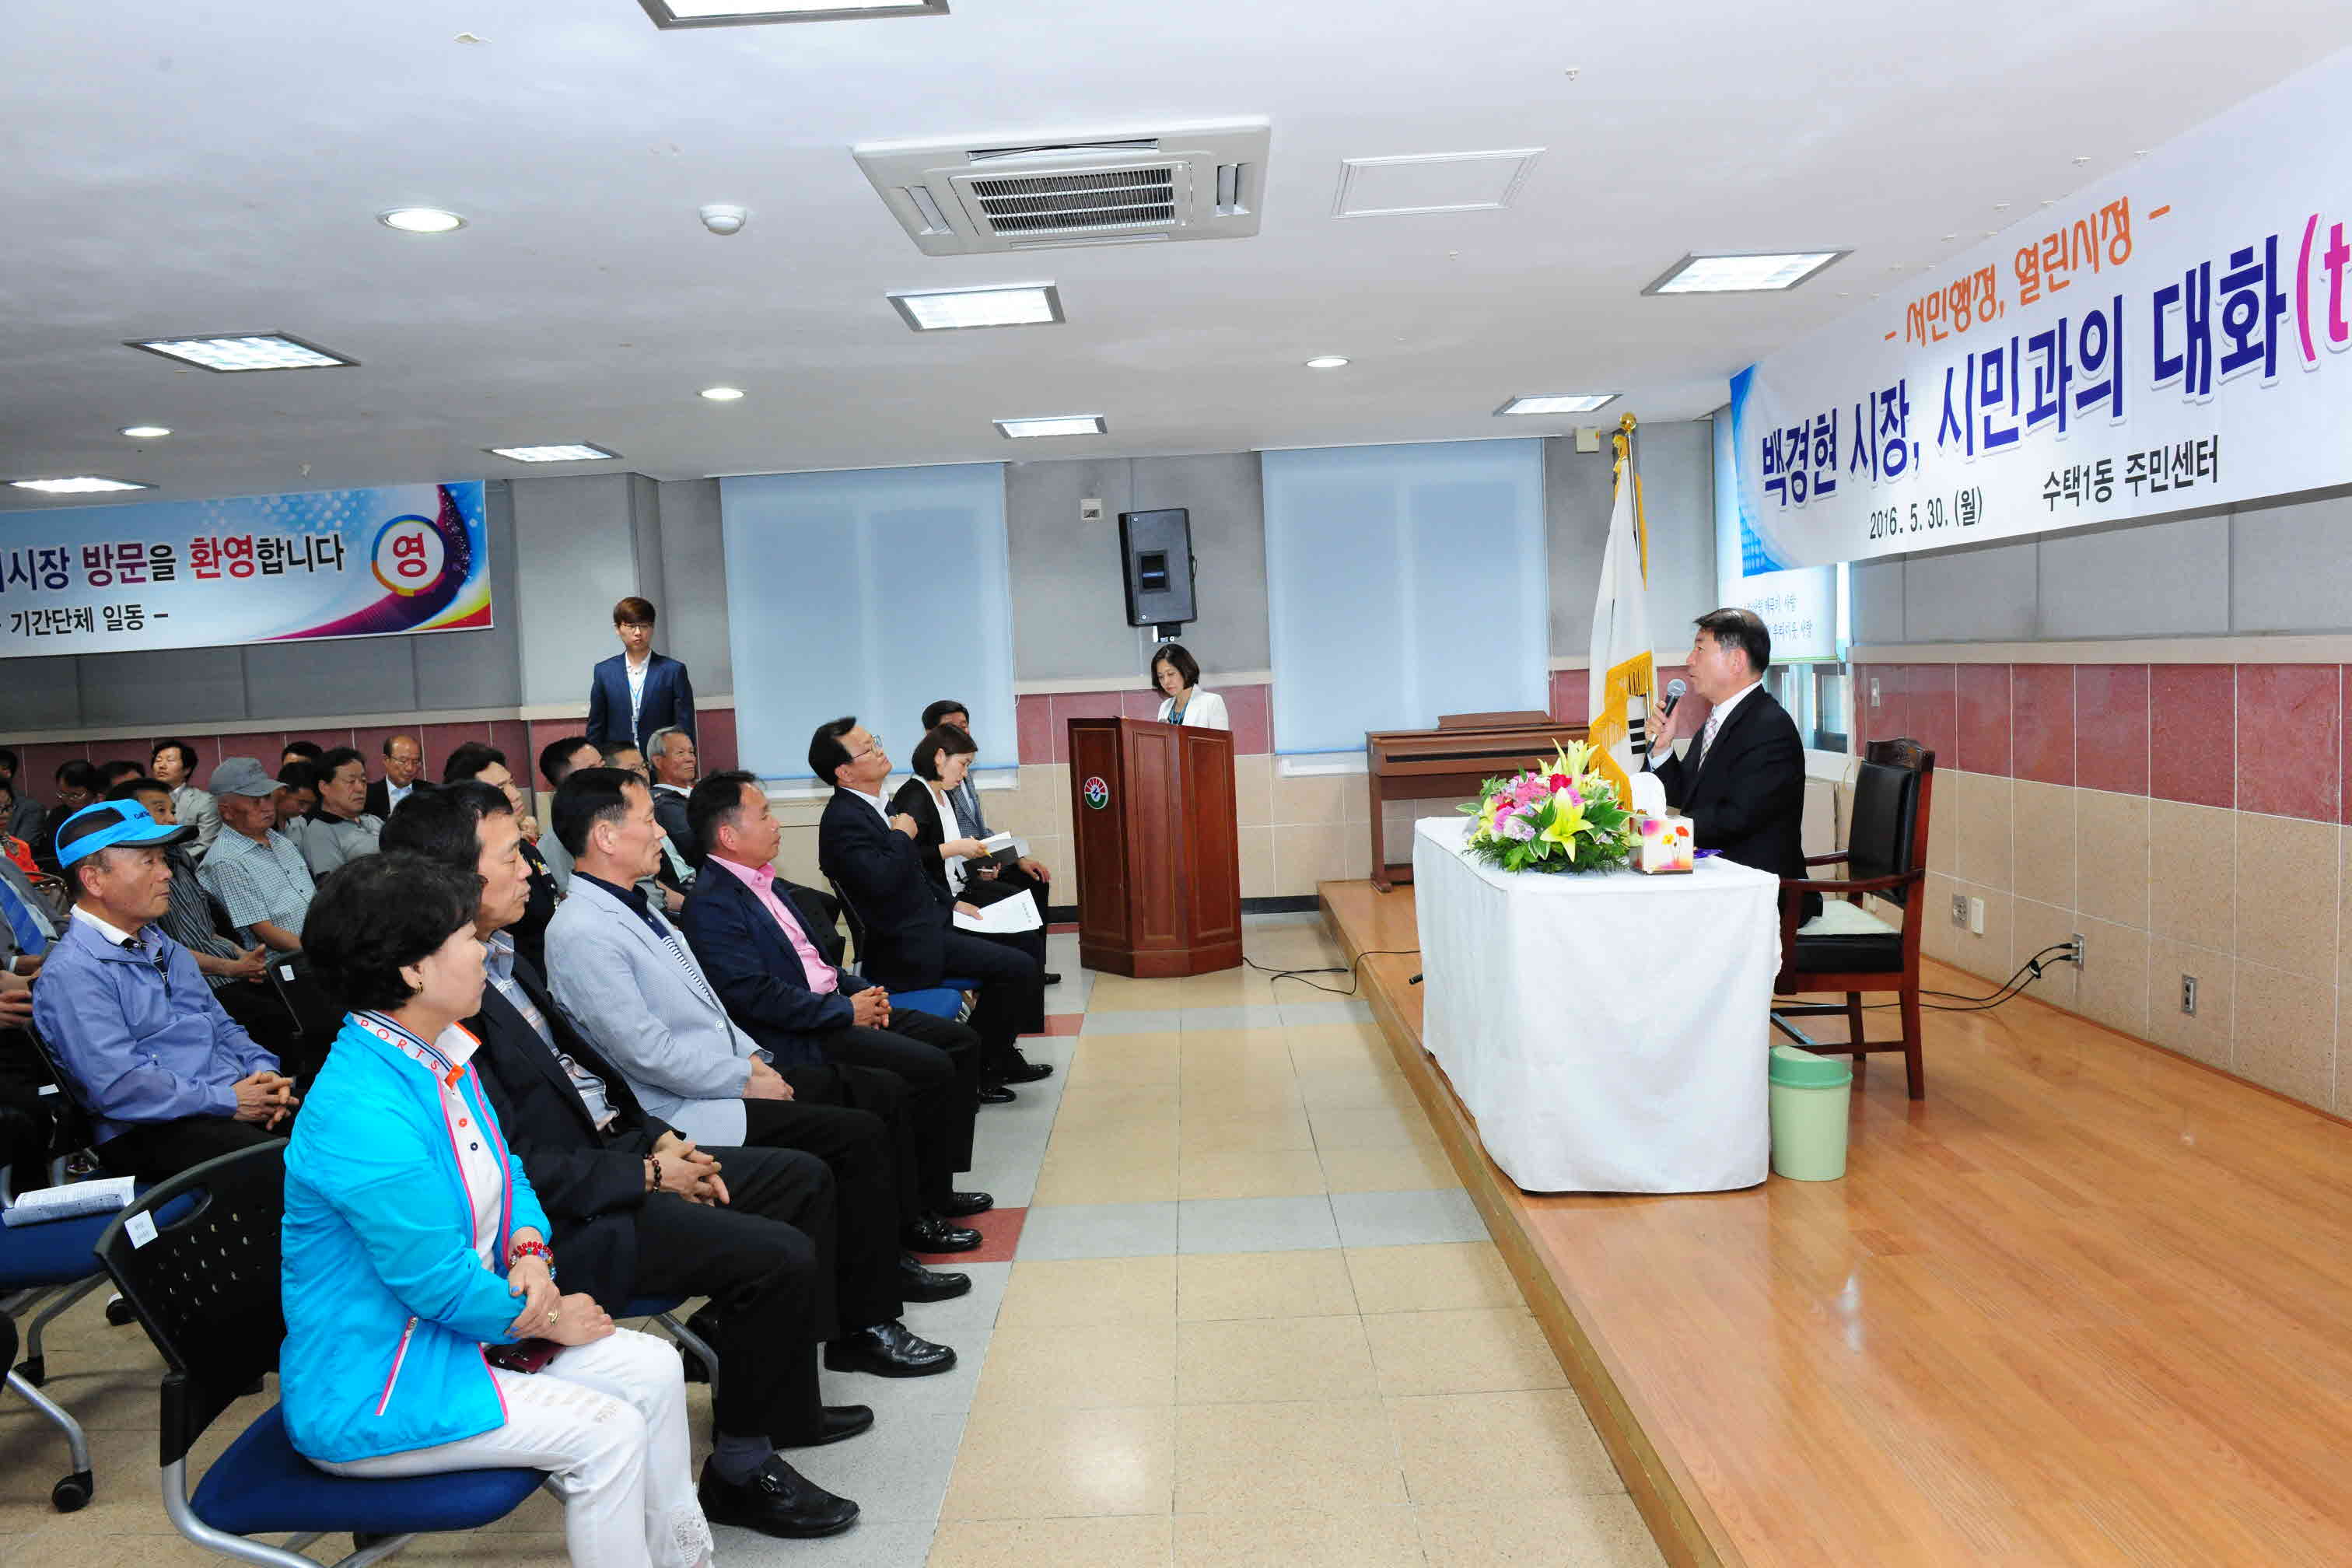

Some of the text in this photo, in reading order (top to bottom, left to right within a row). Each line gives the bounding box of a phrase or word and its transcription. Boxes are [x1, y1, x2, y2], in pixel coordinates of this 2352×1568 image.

[1906, 263, 2005, 348] 서민행정,
[2014, 195, 2133, 306] 열린시정
[1762, 407, 1838, 506] 백경현
[1849, 379, 1920, 482] 시장,
[1936, 293, 2123, 457] 시민과의
[2042, 434, 2219, 513] 수택1동 주민센터
[0, 534, 345, 592] 시장 방문을 환영합니다
[392, 532, 429, 578] 영
[11, 606, 95, 637] 기간단체
[103, 604, 145, 632] 일동
